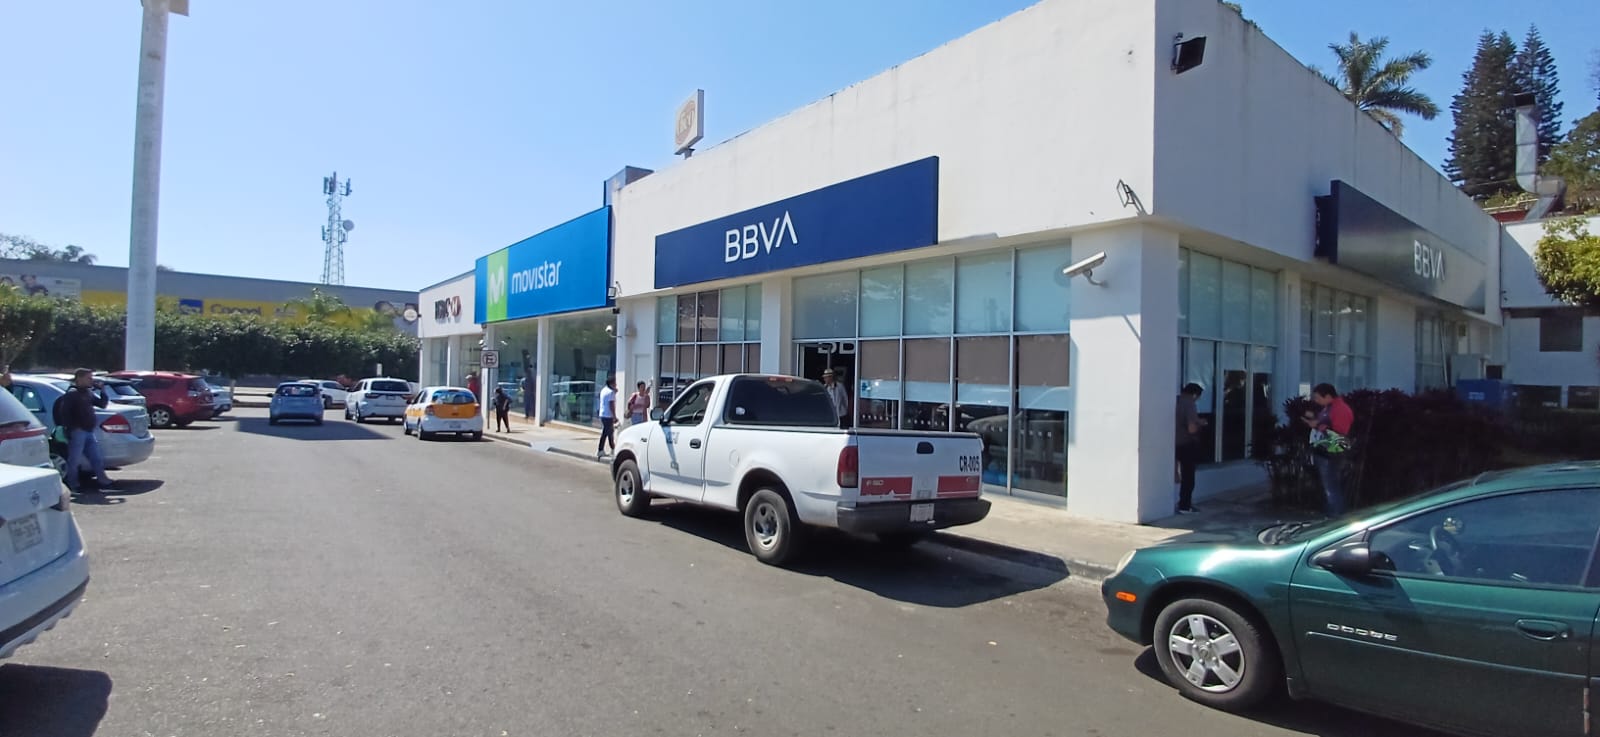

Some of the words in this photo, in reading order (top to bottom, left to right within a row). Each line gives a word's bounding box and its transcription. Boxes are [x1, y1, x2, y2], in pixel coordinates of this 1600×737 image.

[724, 210, 799, 264] BBVA
[511, 260, 563, 295] movistar
[1413, 239, 1446, 281] BBVA
[959, 455, 980, 472] CR-005
[1326, 622, 1399, 641] DODGE
